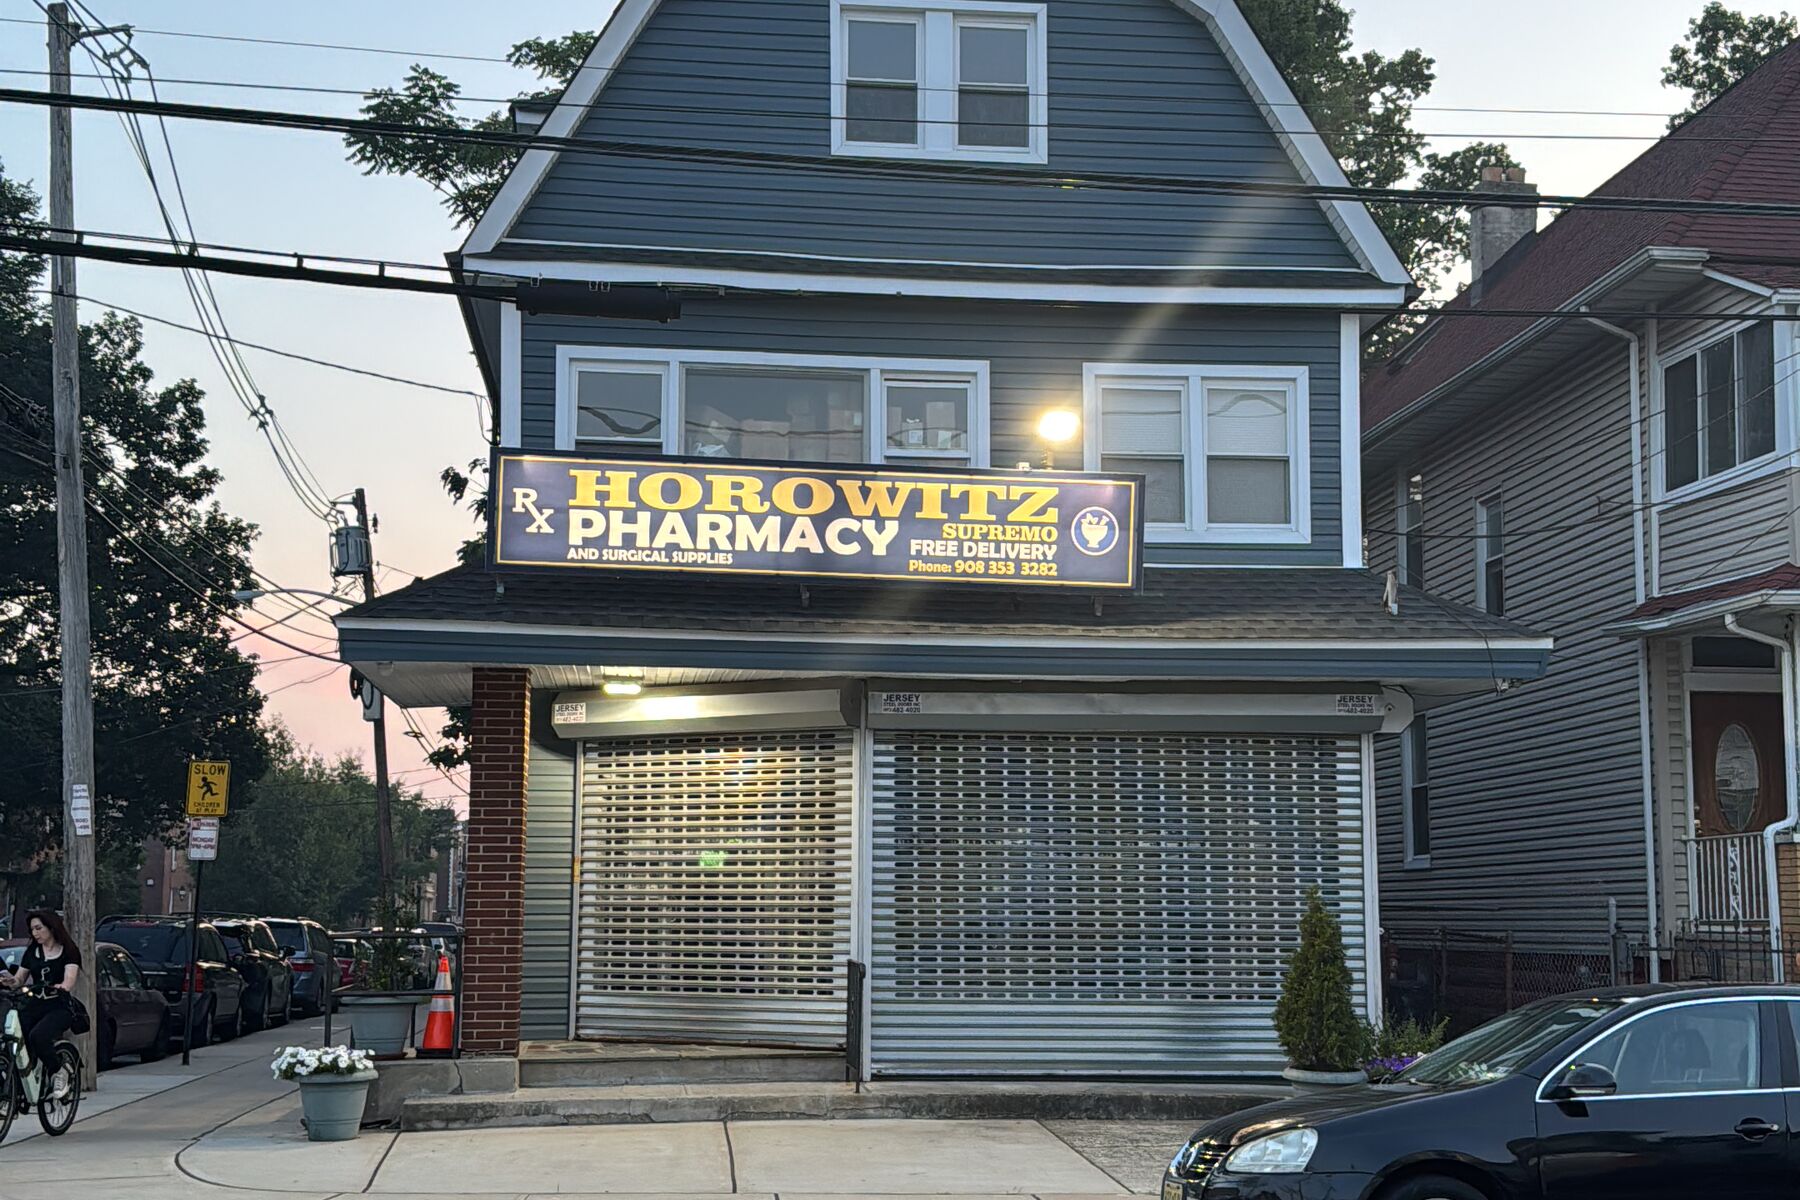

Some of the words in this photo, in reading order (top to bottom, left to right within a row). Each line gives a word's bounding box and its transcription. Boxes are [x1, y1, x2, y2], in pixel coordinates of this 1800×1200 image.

[568, 468, 1059, 523] HOROWITZ
[567, 508, 899, 556] PHARMACY
[942, 522, 1058, 543] SUPREMO
[567, 547, 599, 560] AND
[602, 548, 670, 563] SURGICAL
[672, 550, 733, 565] SUPPLIES
[910, 539, 958, 557] FREE
[963, 540, 1058, 560] DELIVERY
[909, 559, 952, 574] Phone:
[954, 559, 985, 575] 908
[988, 560, 1016, 576] 353
[1020, 561, 1058, 577] 3282
[556, 704, 584, 712] JERSEY
[194, 764, 226, 776] SLOW
